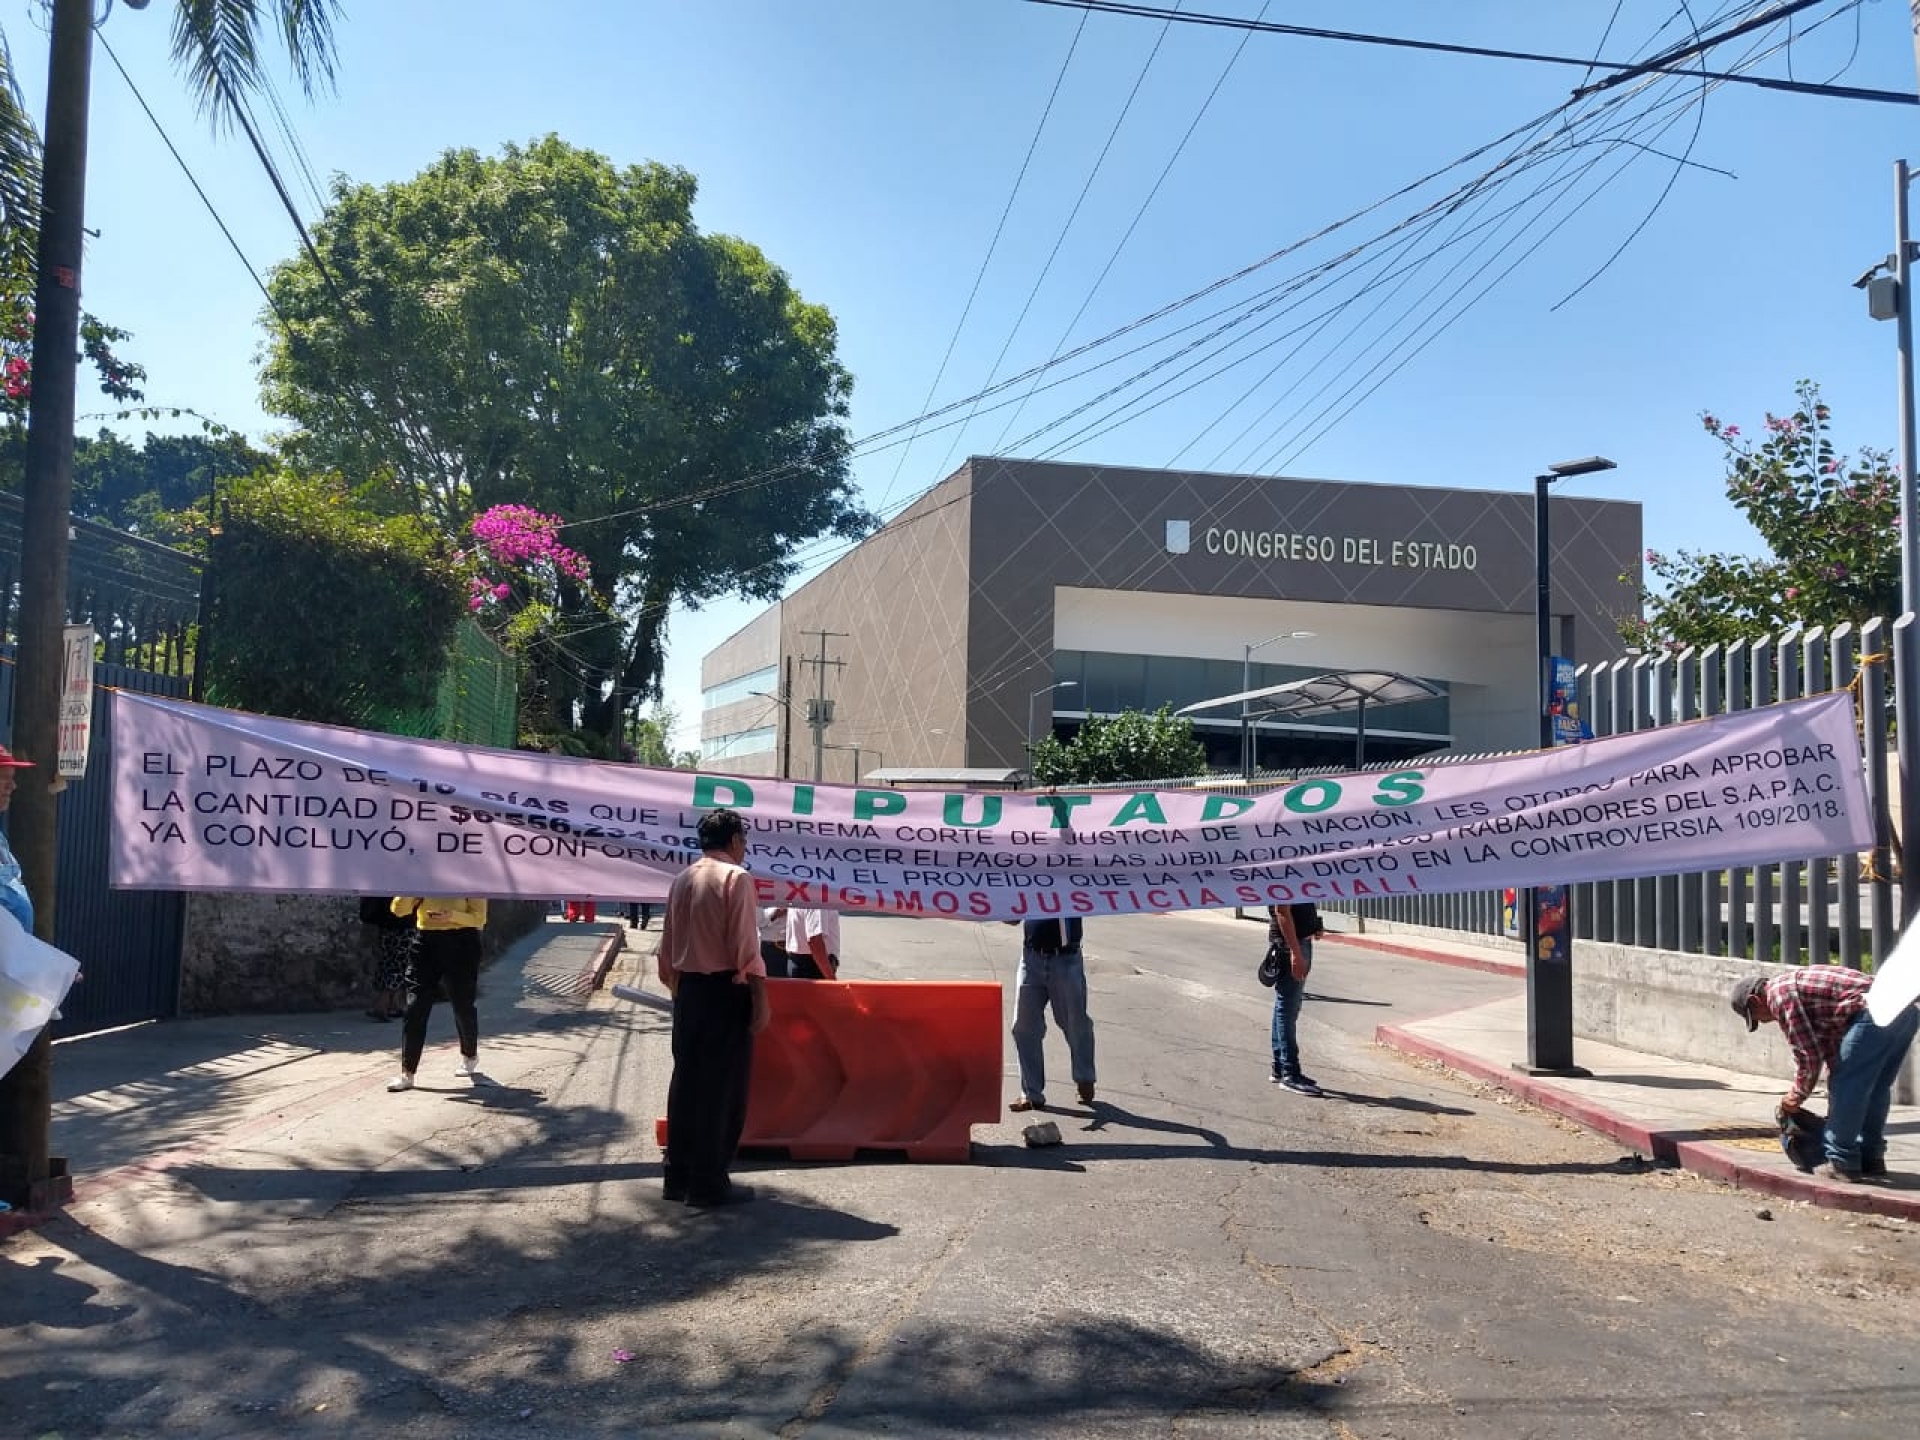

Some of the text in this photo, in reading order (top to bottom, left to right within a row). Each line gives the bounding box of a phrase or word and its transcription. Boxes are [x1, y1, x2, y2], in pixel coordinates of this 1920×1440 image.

[1206, 527, 1478, 571] CONGRESO DEL ESTADO
[142, 788, 185, 813] LA
[194, 791, 378, 821] CANTIDAD
[389, 799, 438, 822] DE
[801, 846, 904, 866] HACER
[914, 850, 949, 867] EL
[957, 851, 1037, 868] PAGO
[1046, 853, 1084, 868] DE
[1093, 853, 1147, 868] LAS
[1665, 792, 1717, 812] DEL
[1722, 774, 1842, 806] S.A.P.A.C.
[143, 752, 184, 775] EL
[206, 755, 323, 781] PLAZO
[342, 767, 390, 787] DE
[590, 803, 660, 826] QUE
[740, 817, 881, 840] SUPREMA
[896, 825, 994, 845] CORTE
[1010, 830, 1049, 846] DE
[1064, 828, 1190, 846] JUSTICIA
[1201, 824, 1241, 842] DE
[1255, 822, 1292, 838] LA
[1302, 810, 1422, 836] NACIÓN,
[1434, 801, 1490, 822] LES
[1630, 761, 1700, 788] PARA
[1711, 743, 1837, 777] APROBAR
[692, 771, 1425, 830] DIPUTADOS
[141, 821, 186, 844] YA
[203, 824, 416, 856] CONCLUYÓ,
[437, 832, 484, 855] DE
[770, 863, 836, 882] CON
[853, 869, 889, 885] EL
[1069, 874, 1132, 888] QUE
[1143, 872, 1179, 886] LA
[1229, 864, 1303, 882] SALA
[1312, 852, 1399, 878] DICTÓ
[1411, 847, 1452, 868] EN
[1464, 843, 1501, 864] LA
[1511, 815, 1723, 860] CONTROVERSIA
[1735, 800, 1846, 830] 109/2018.
[1010, 888, 1225, 916] JUSTICIA
